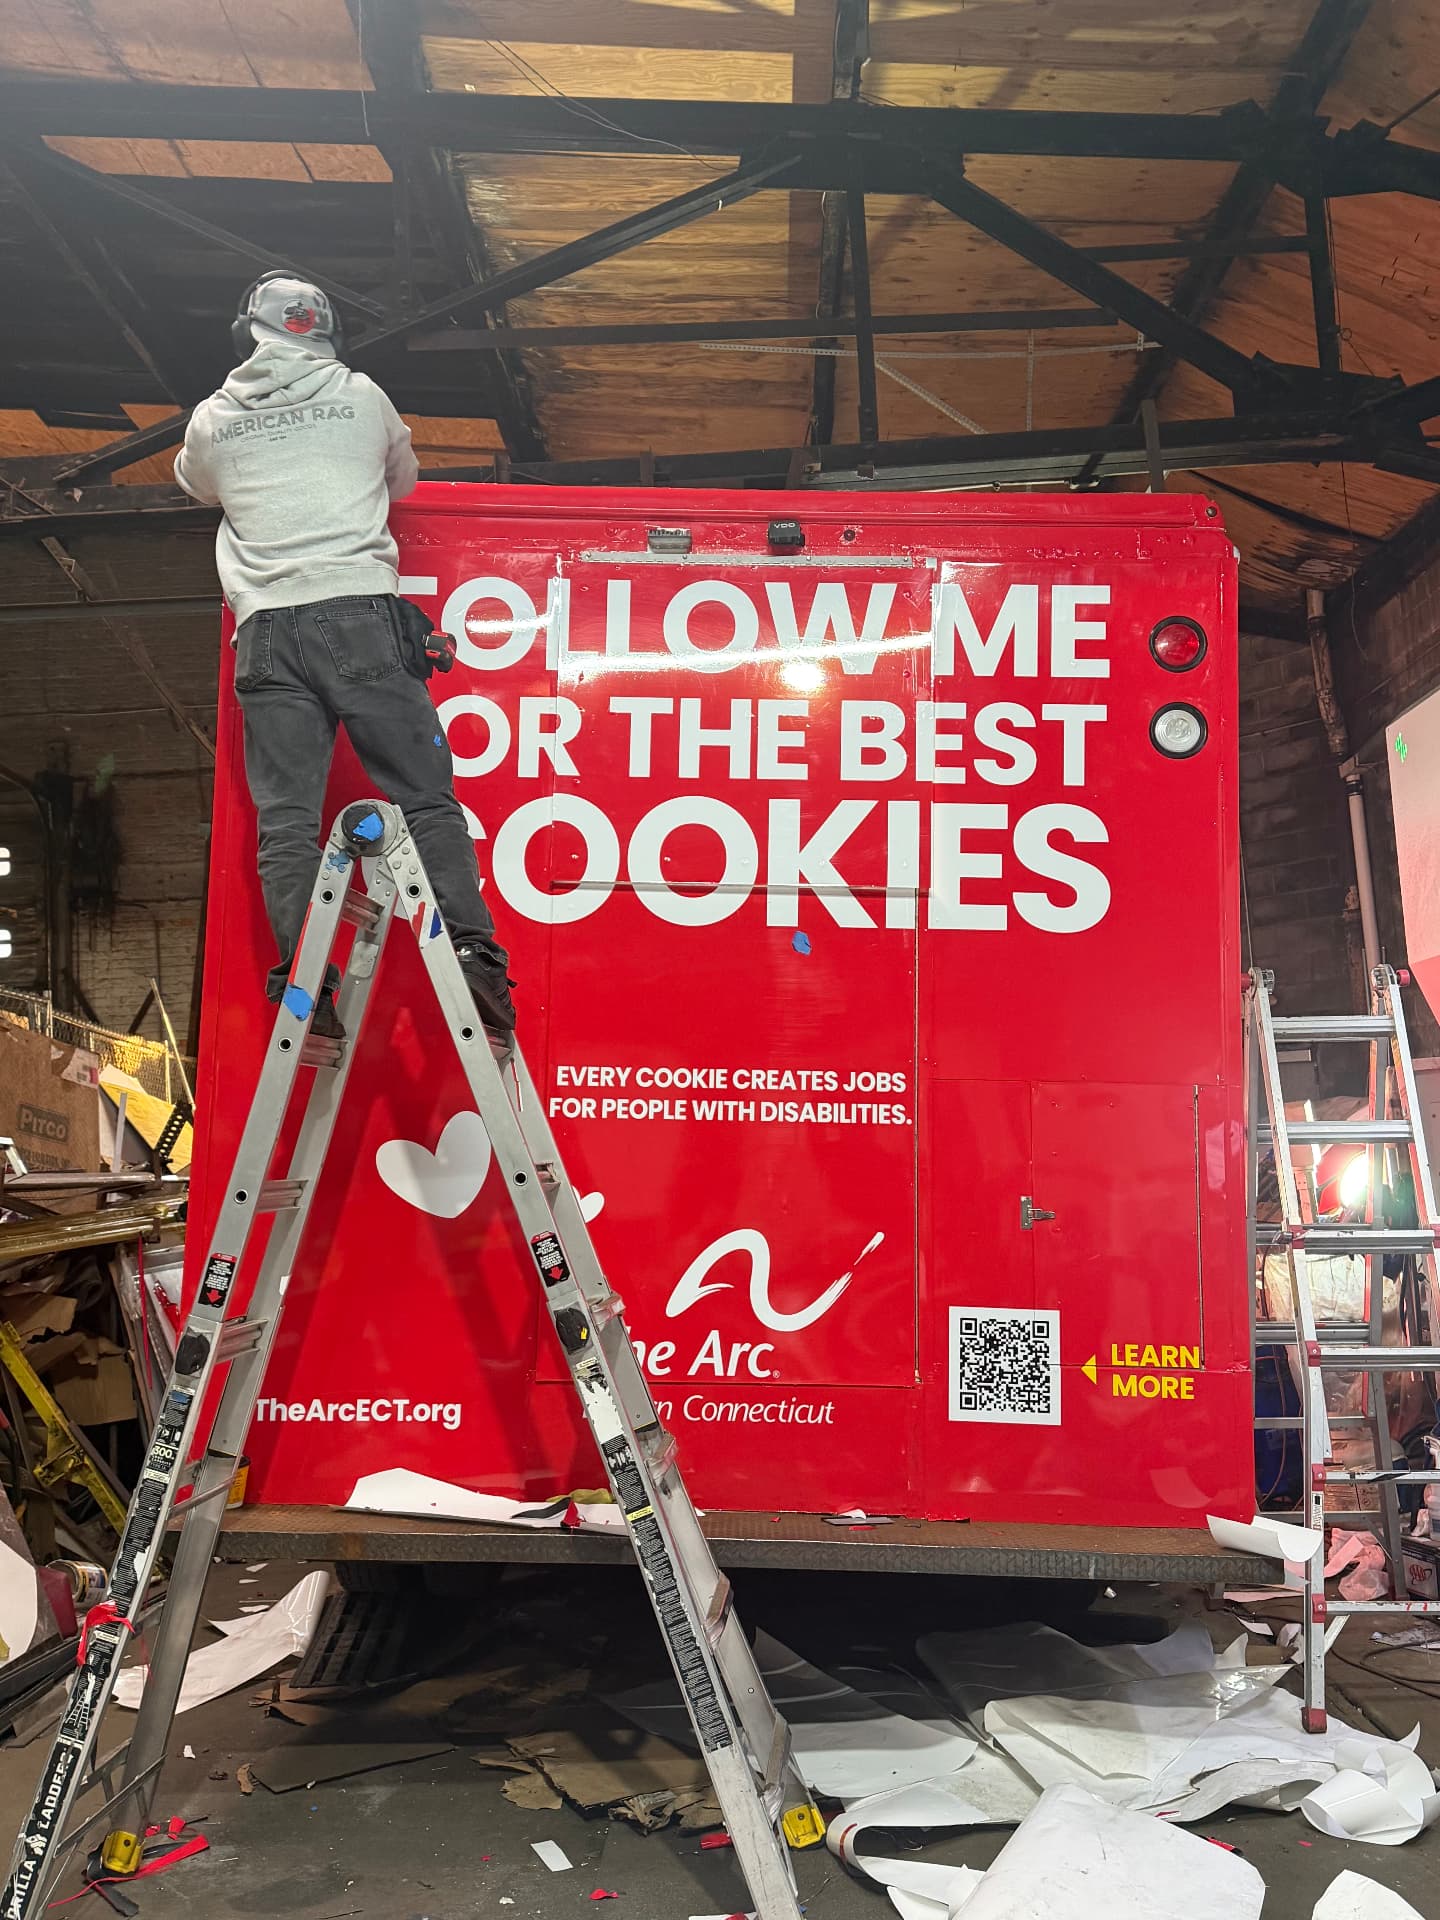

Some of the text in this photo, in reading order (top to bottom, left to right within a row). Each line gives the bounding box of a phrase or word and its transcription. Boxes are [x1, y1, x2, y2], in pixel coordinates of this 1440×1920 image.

[211, 405, 355, 448] AMERICAN RAG
[932, 583, 1110, 678] ME
[452, 695, 1108, 786] OR THE BEST
[556, 1066, 906, 1093] EVERY COOKIE CREATES JOBS
[549, 1097, 912, 1125] FOR PEOPLE WITH DISABILITIES.
[1111, 1343, 1200, 1369] LEARN
[1112, 1373, 1195, 1400] MORE
[256, 1397, 462, 1430] TheArcECT.org
[683, 1395, 834, 1424] Connecticut
